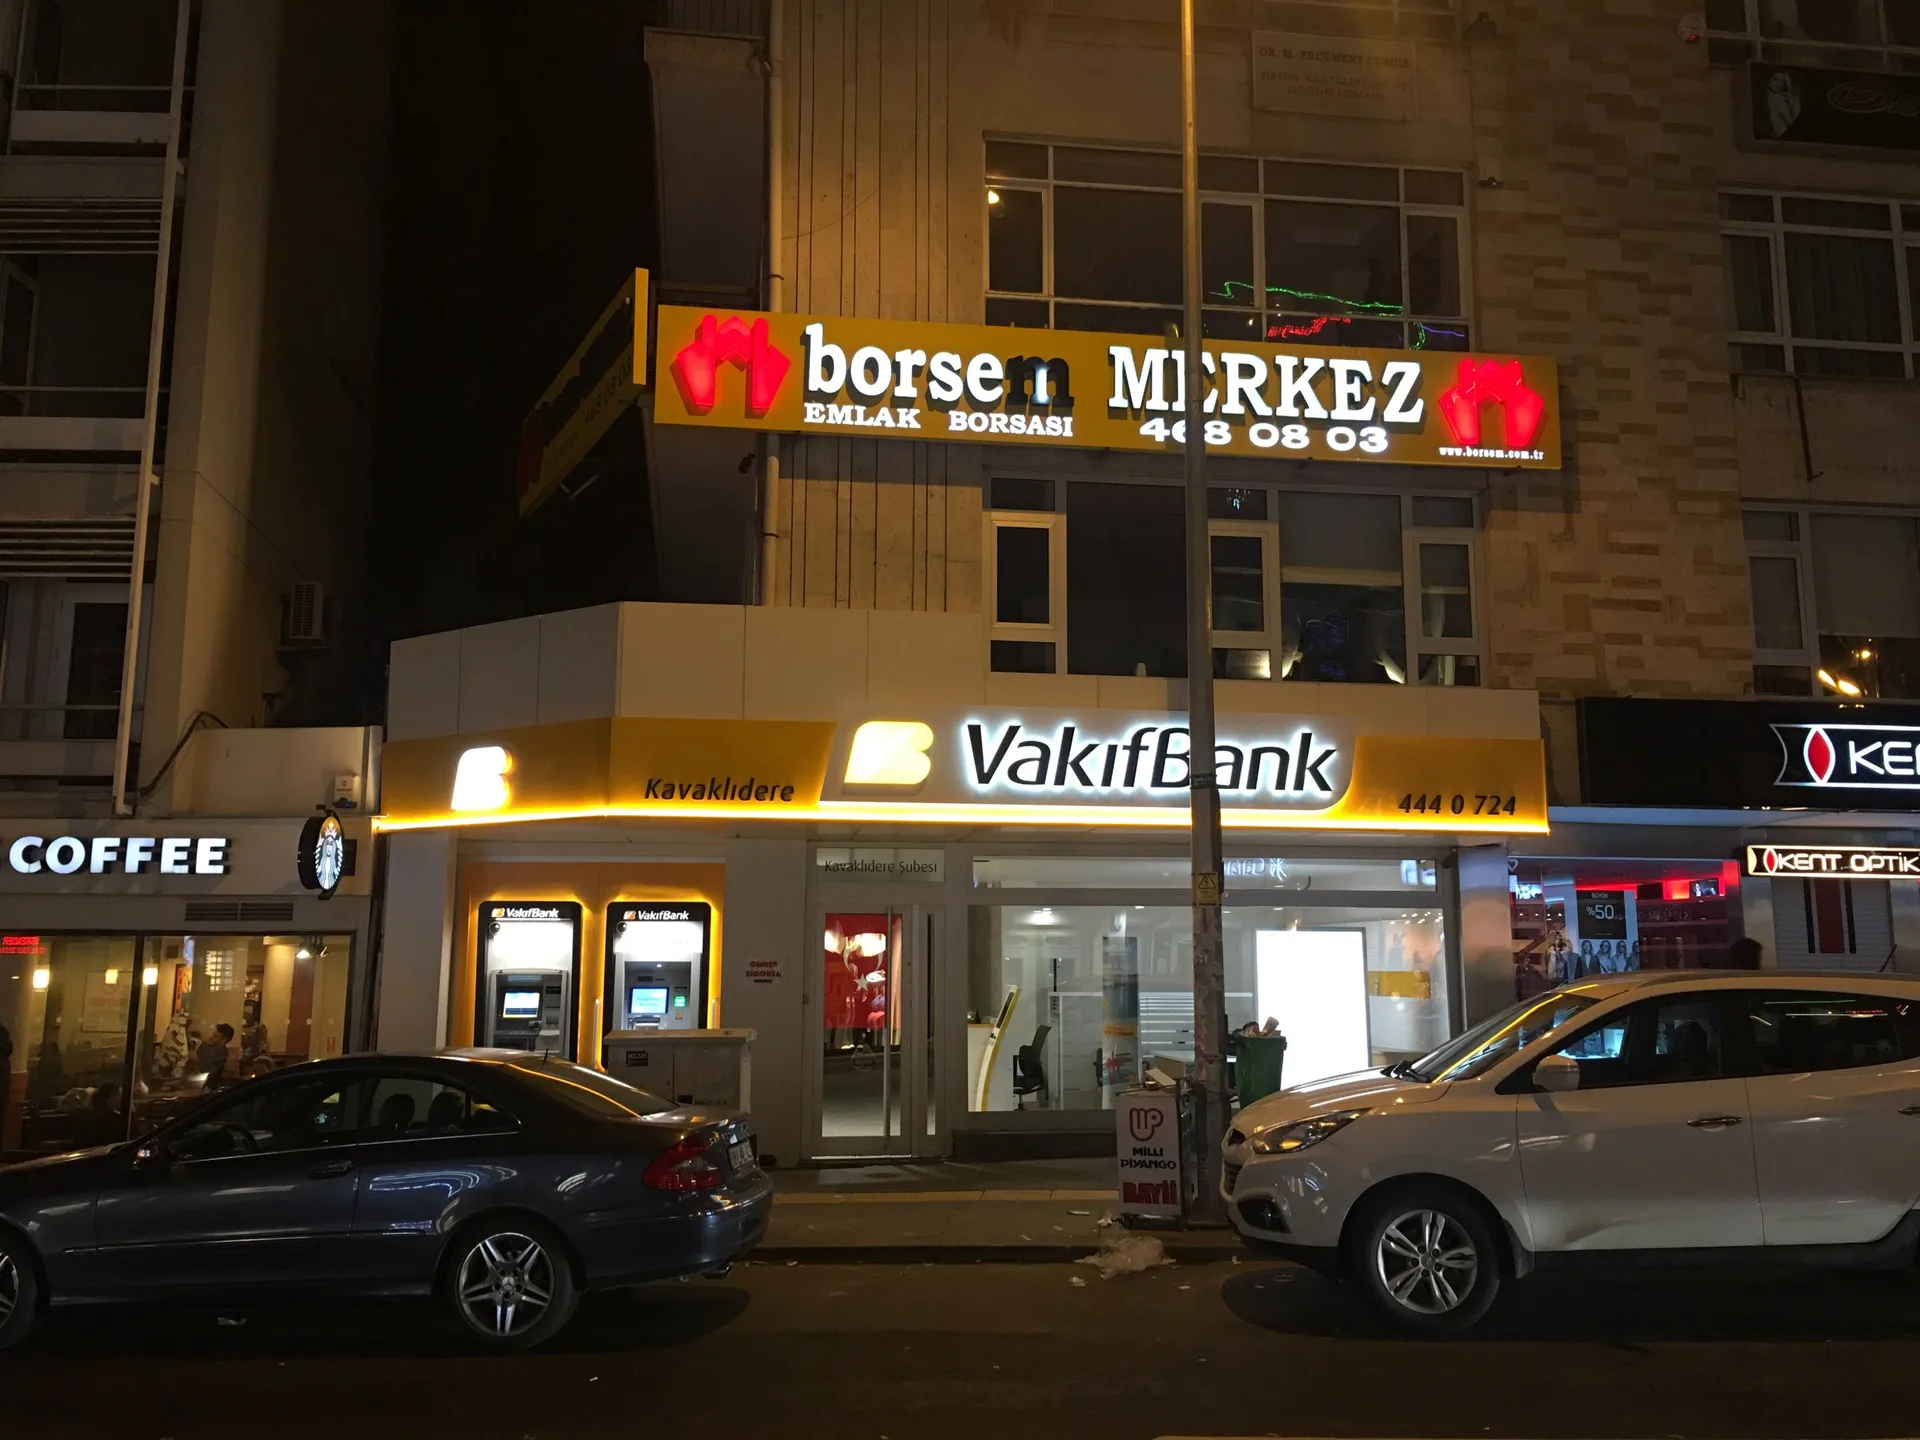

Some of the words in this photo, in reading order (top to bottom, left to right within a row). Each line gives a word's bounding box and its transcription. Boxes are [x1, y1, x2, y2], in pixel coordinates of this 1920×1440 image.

[804, 322, 1074, 406] borsem
[1108, 346, 1424, 424] MERKEZ
[804, 403, 921, 429] EMLAK
[948, 411, 1073, 437] BORSASI
[1249, 422, 1310, 449] 08
[1326, 426, 1389, 453] 03
[1439, 445, 1544, 460] www.borsem.com.tr
[1848, 740, 1920, 776] KE
[1398, 793, 1442, 814] 444
[1450, 794, 1465, 815] 0
[1473, 795, 1516, 815] 724
[8, 836, 228, 875] COFFEE
[1778, 852, 1842, 871] KENT
[1586, 904, 1614, 920] %50
